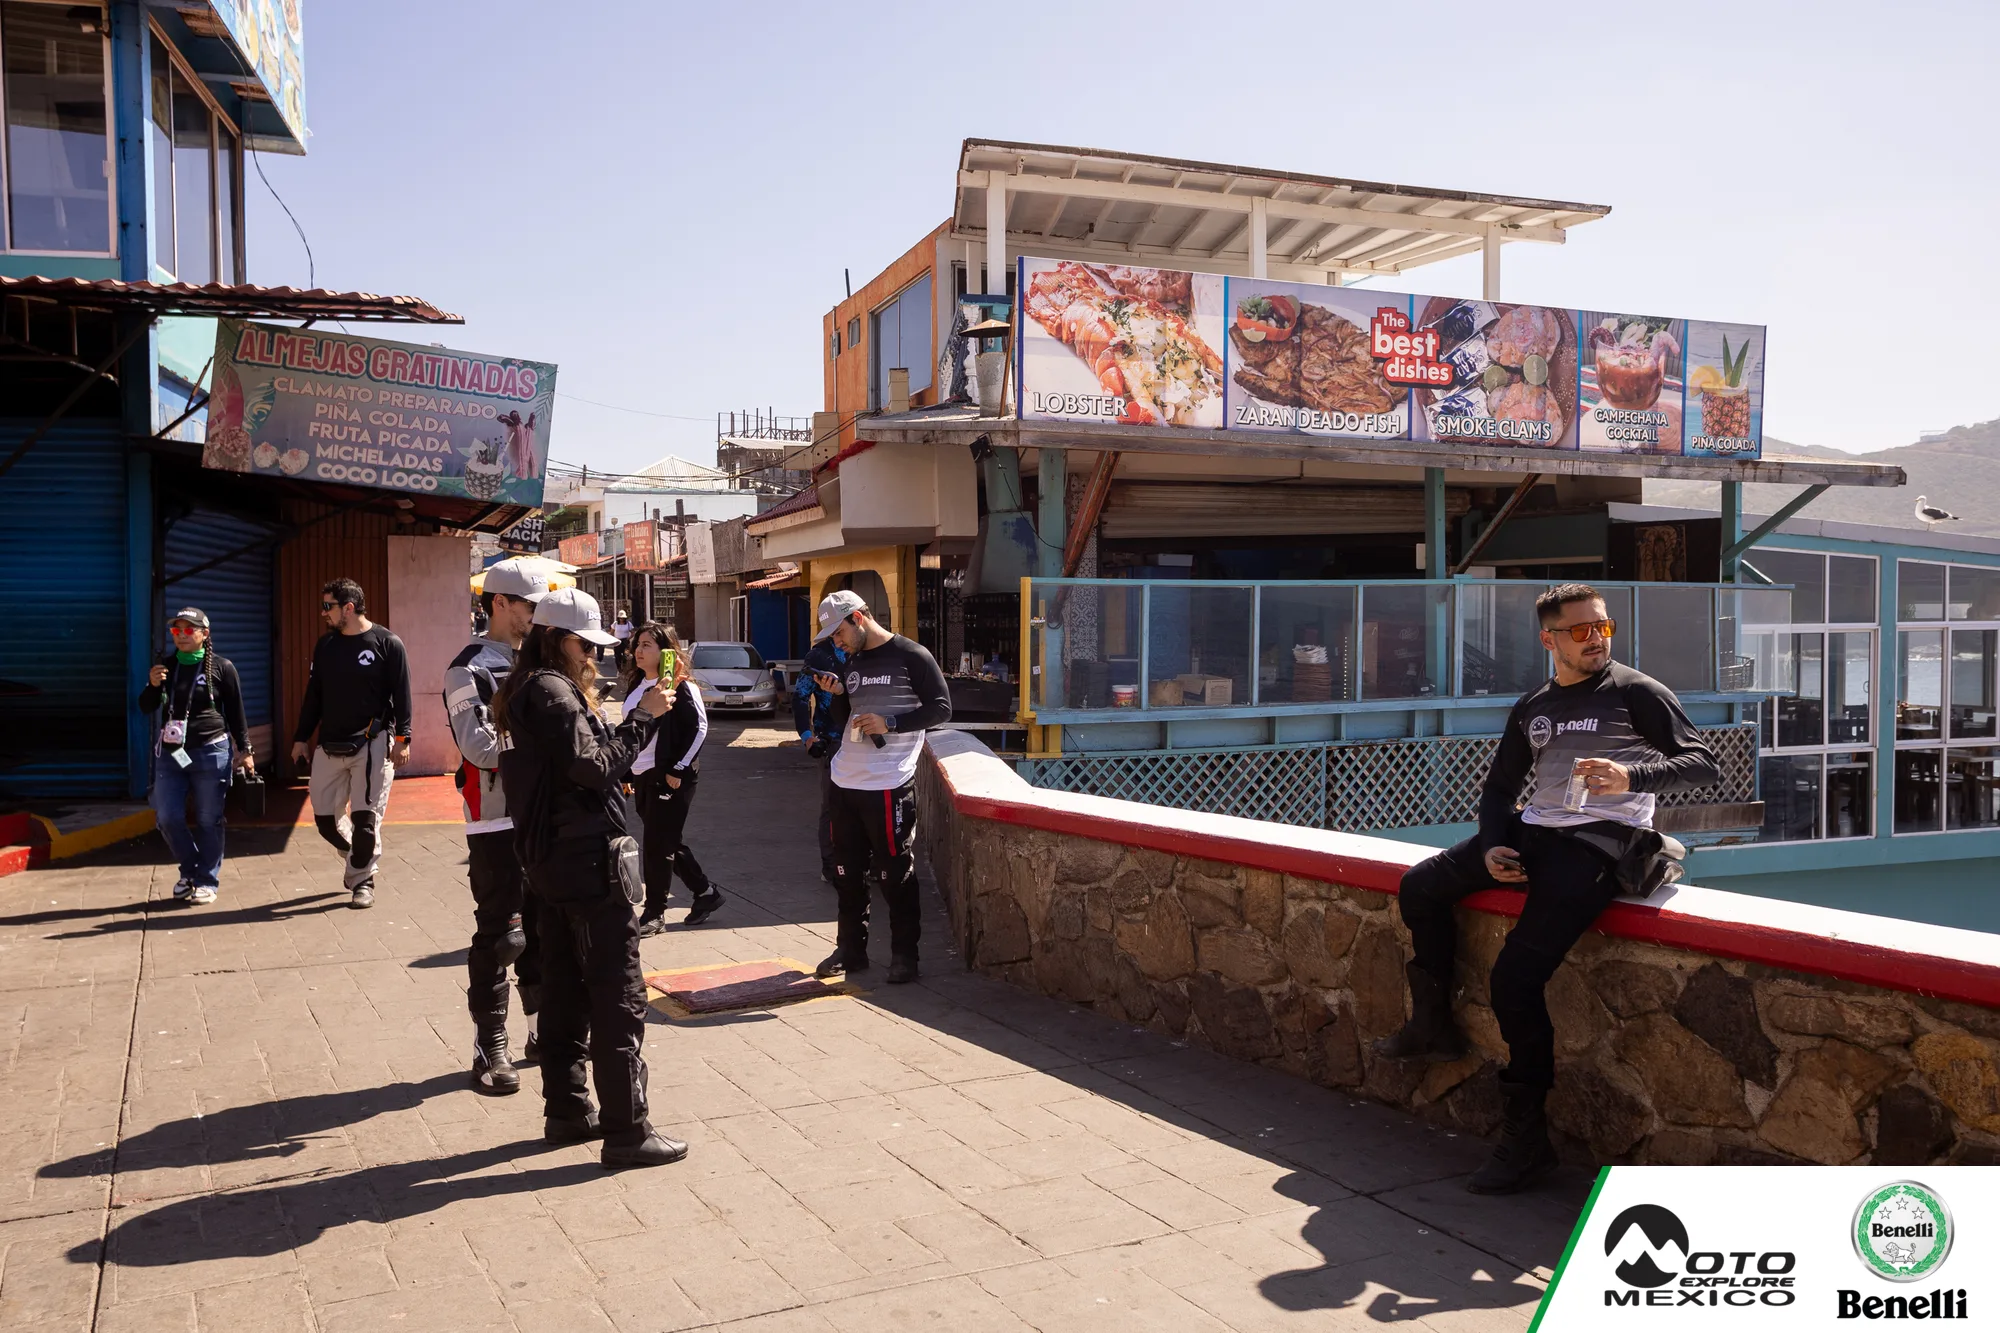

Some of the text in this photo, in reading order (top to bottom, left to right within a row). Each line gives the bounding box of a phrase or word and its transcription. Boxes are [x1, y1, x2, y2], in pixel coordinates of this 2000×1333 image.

[1382, 312, 1406, 329] The
[1374, 329, 1436, 358] best
[236, 328, 539, 401] ALMEJAS GRATINADAS
[1386, 356, 1449, 382] dishes
[273, 376, 498, 421] CLAMATO PREPARADO
[1033, 391, 1129, 418] LOBSTER
[315, 401, 452, 435] PIÑA COLADA
[1235, 405, 1401, 434] ZARANDEADO FISH
[1436, 415, 1552, 441] SMOKE CLAMS
[1594, 409, 1669, 427] CAMPECHANA
[308, 421, 454, 455] FRUTA PICADA
[1606, 427, 1659, 442] COCKTAIL
[1692, 436, 1758, 452] PIÑA COLADA
[316, 443, 444, 473] MICHELADAS
[317, 464, 438, 491] COCO LOCO
[862, 674, 891, 686] Benelli
